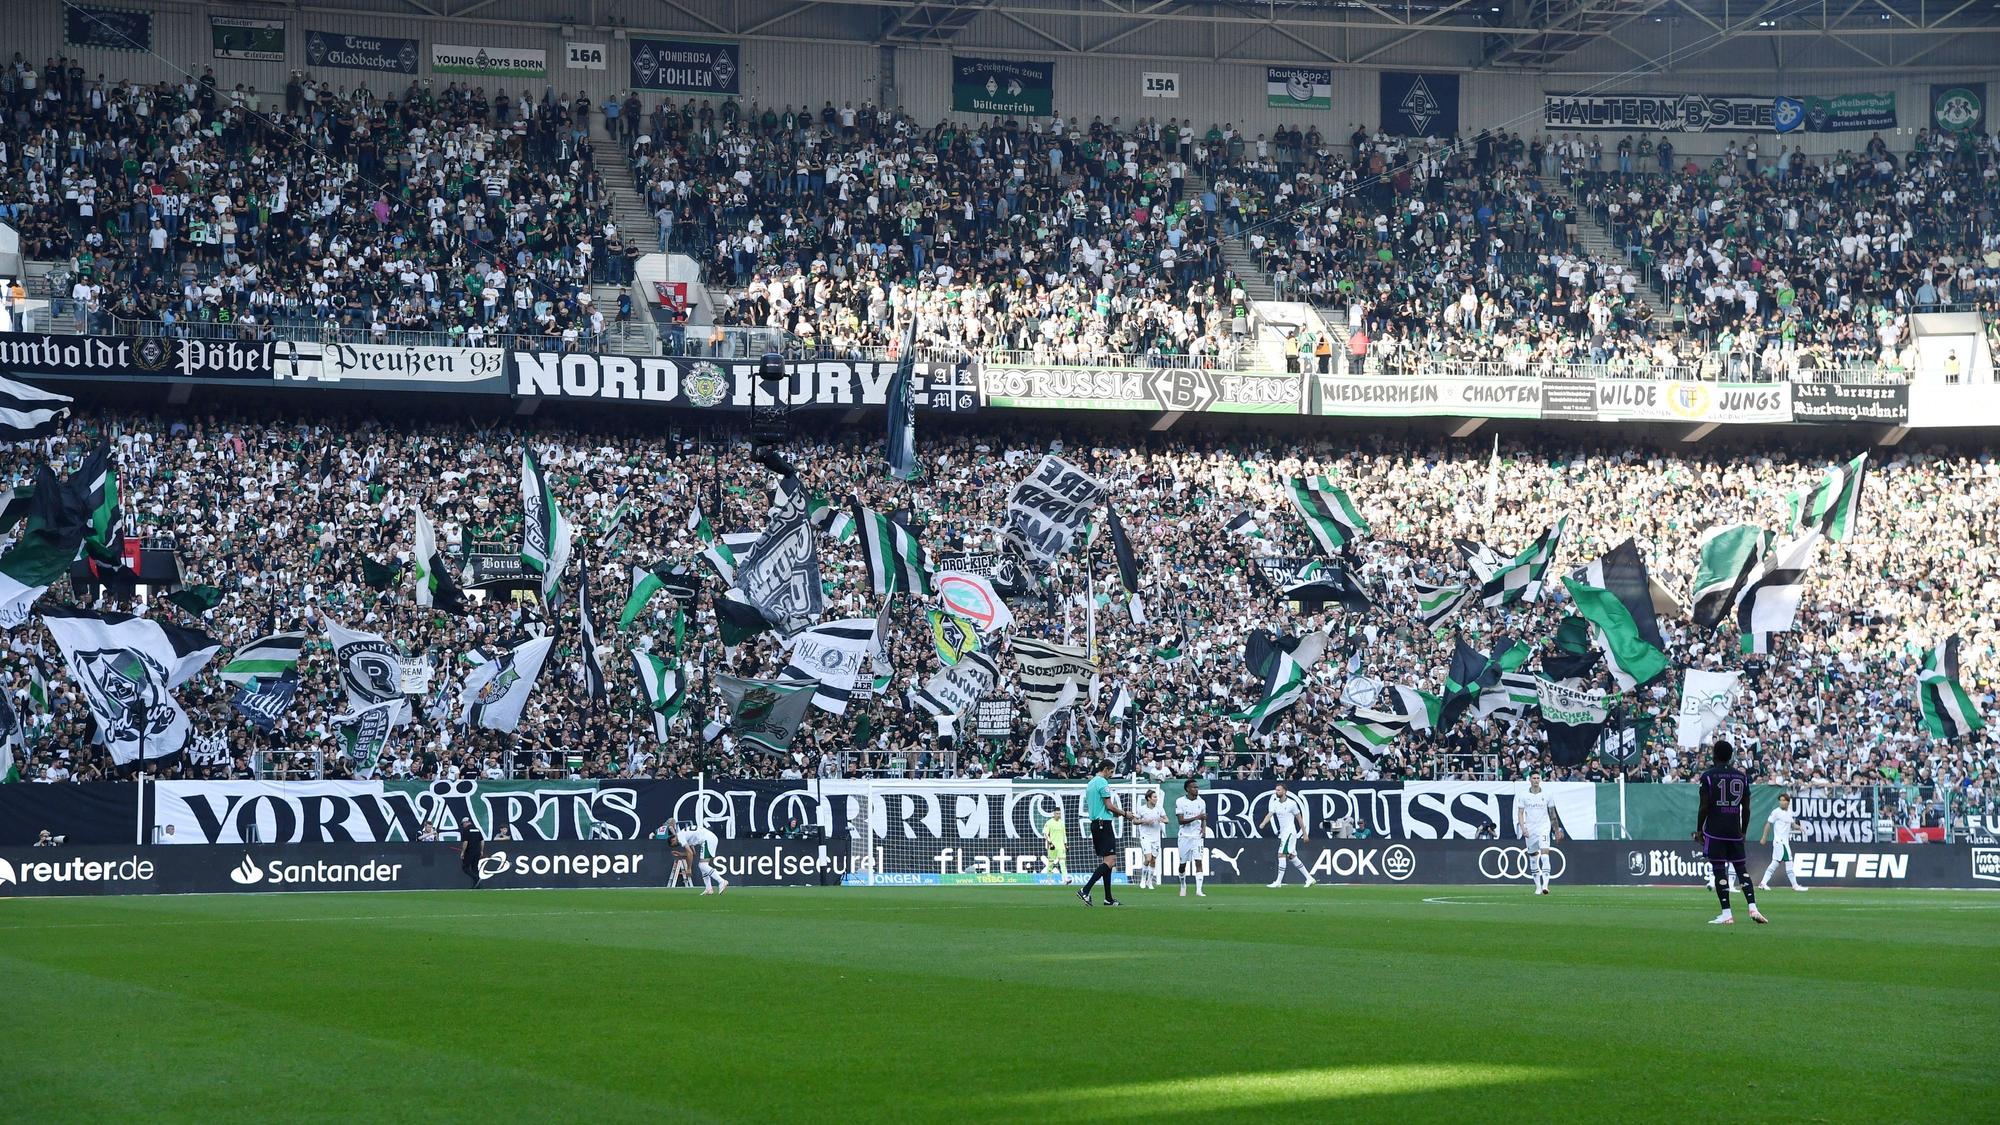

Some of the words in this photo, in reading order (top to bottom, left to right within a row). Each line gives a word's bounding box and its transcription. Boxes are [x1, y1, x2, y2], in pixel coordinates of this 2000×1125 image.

[345, 36, 381, 50] Treue
[571, 48, 602, 63] 16A
[328, 51, 397, 69] Gladbacher
[436, 55, 474, 66] YOUNG
[513, 60, 543, 69] BORN
[659, 50, 712, 64] PONDEROSA
[658, 67, 713, 87] FOHLEN
[1146, 78, 1175, 91] 15A
[1547, 98, 1677, 125] HALTERN
[1708, 99, 1775, 126] SEE
[175, 338, 272, 375] Pöbel
[514, 352, 679, 401] NORD
[732, 362, 929, 405] KURVE
[983, 368, 1145, 401] BORUSSIA
[1220, 375, 1301, 404] FANS
[1322, 384, 1439, 402] NIEDERRHEIN
[1462, 384, 1541, 403] CHAOTEN
[1600, 385, 1657, 407] WILDE
[1719, 391, 1781, 411] JUNGS
[481, 556, 523, 570] Borus
[1716, 778, 1744, 806] 19
[180, 781, 641, 843] VORWÄRTS
[1200, 789, 1573, 840] BORUSSI
[1800, 819, 1873, 843] PINKIS
[20, 855, 154, 882] reuter.de
[268, 859, 402, 883] Santander
[515, 852, 644, 879] sonepar
[712, 846, 884, 880] sure[secure]
[934, 847, 1060, 874] flatex
[1310, 848, 1380, 876] AOK
[1793, 853, 1909, 878] ELTEN
[873, 873, 922, 885] ONGEN
